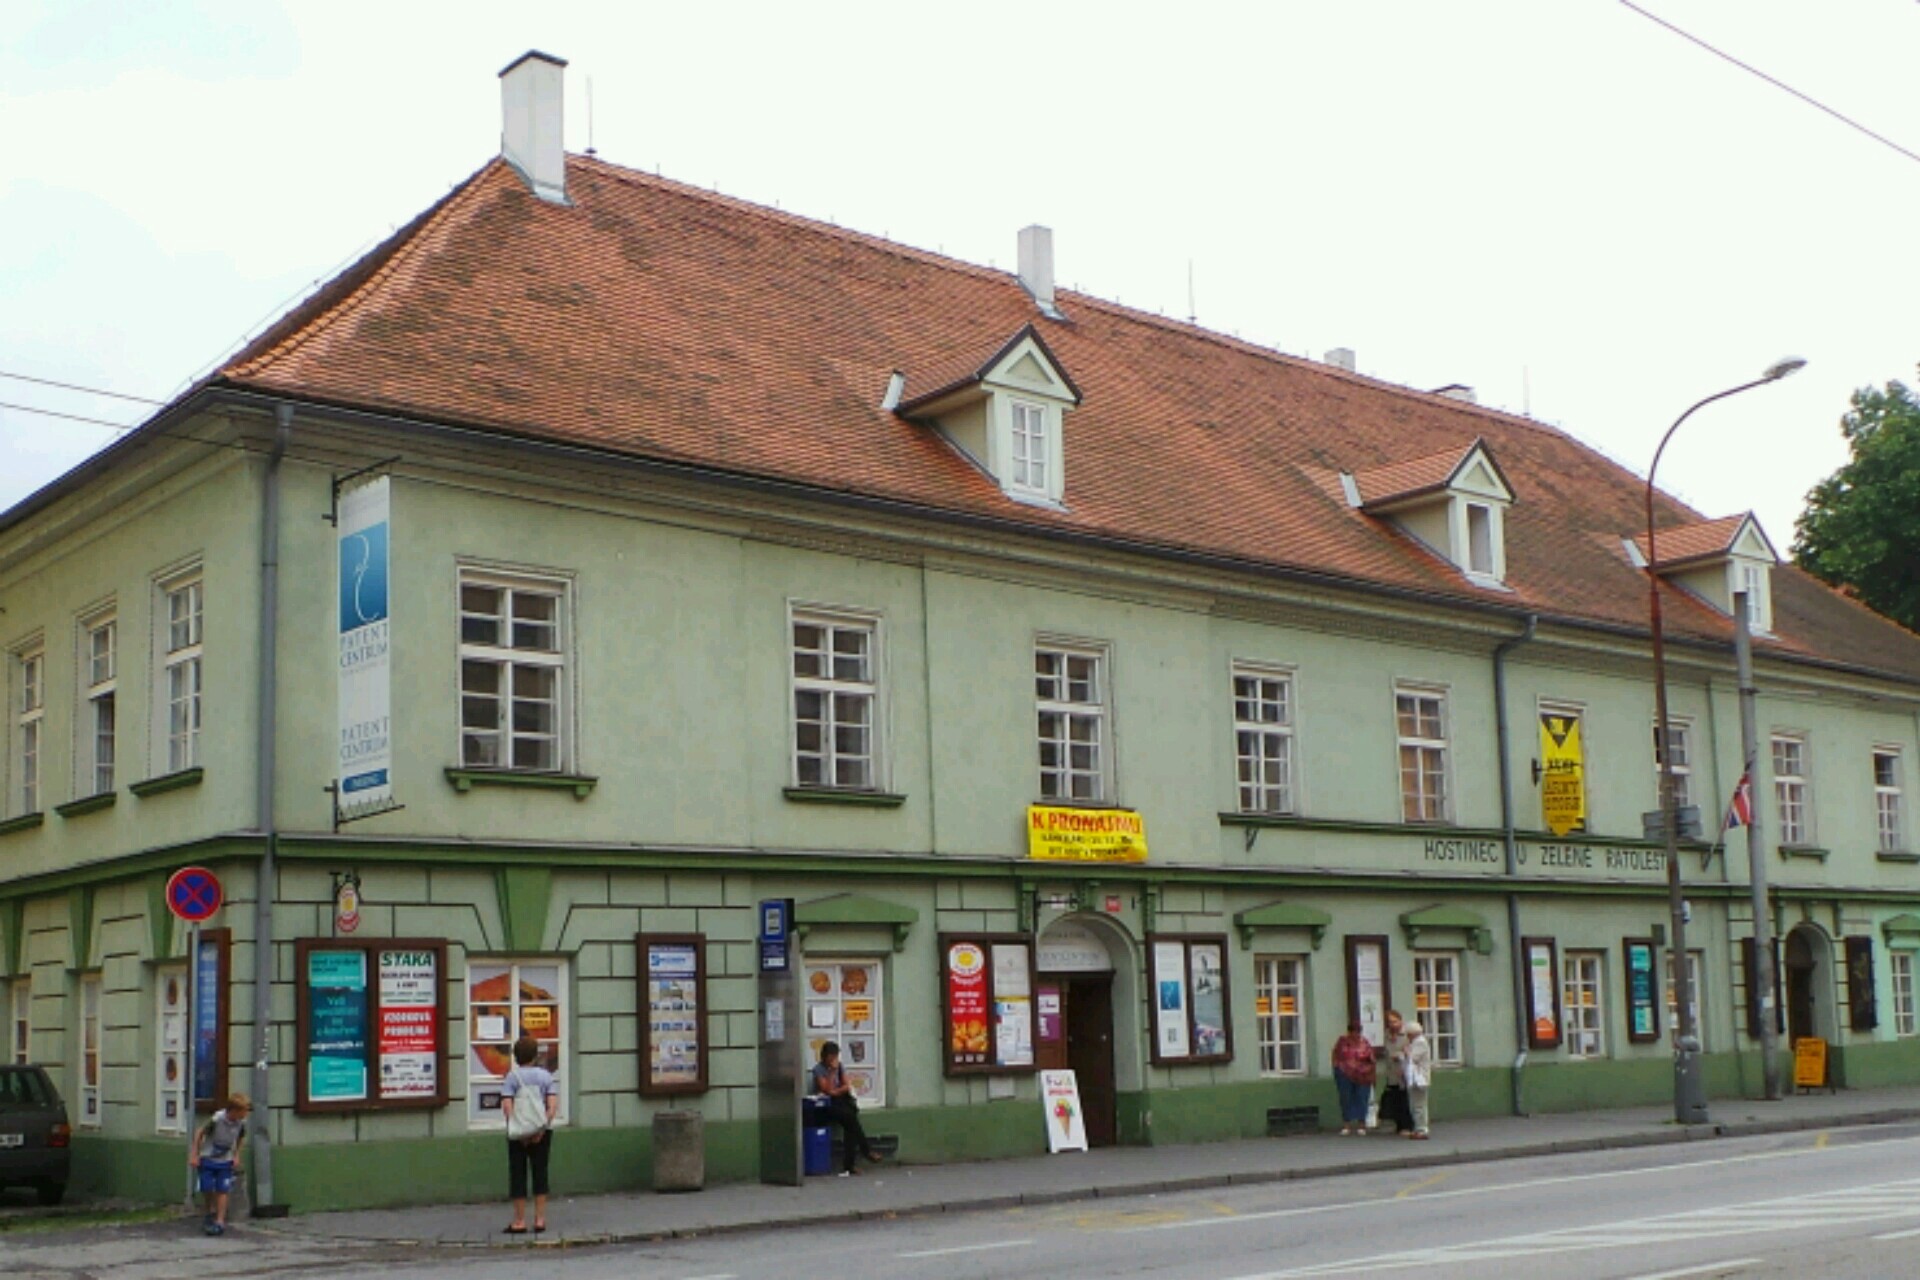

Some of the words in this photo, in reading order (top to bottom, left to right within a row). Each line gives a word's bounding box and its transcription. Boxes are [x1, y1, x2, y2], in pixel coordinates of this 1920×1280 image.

[341, 622, 388, 652] PATENT
[340, 642, 388, 669] CENTRUM
[341, 716, 388, 743] PATENT
[340, 737, 388, 761] CENTRUM
[1032, 812, 1044, 829] K
[1424, 840, 1499, 863] HOSTINEC
[1515, 844, 1527, 865] U
[1605, 848, 1667, 871] RATOLEST
[381, 952, 431, 966] STAKA
